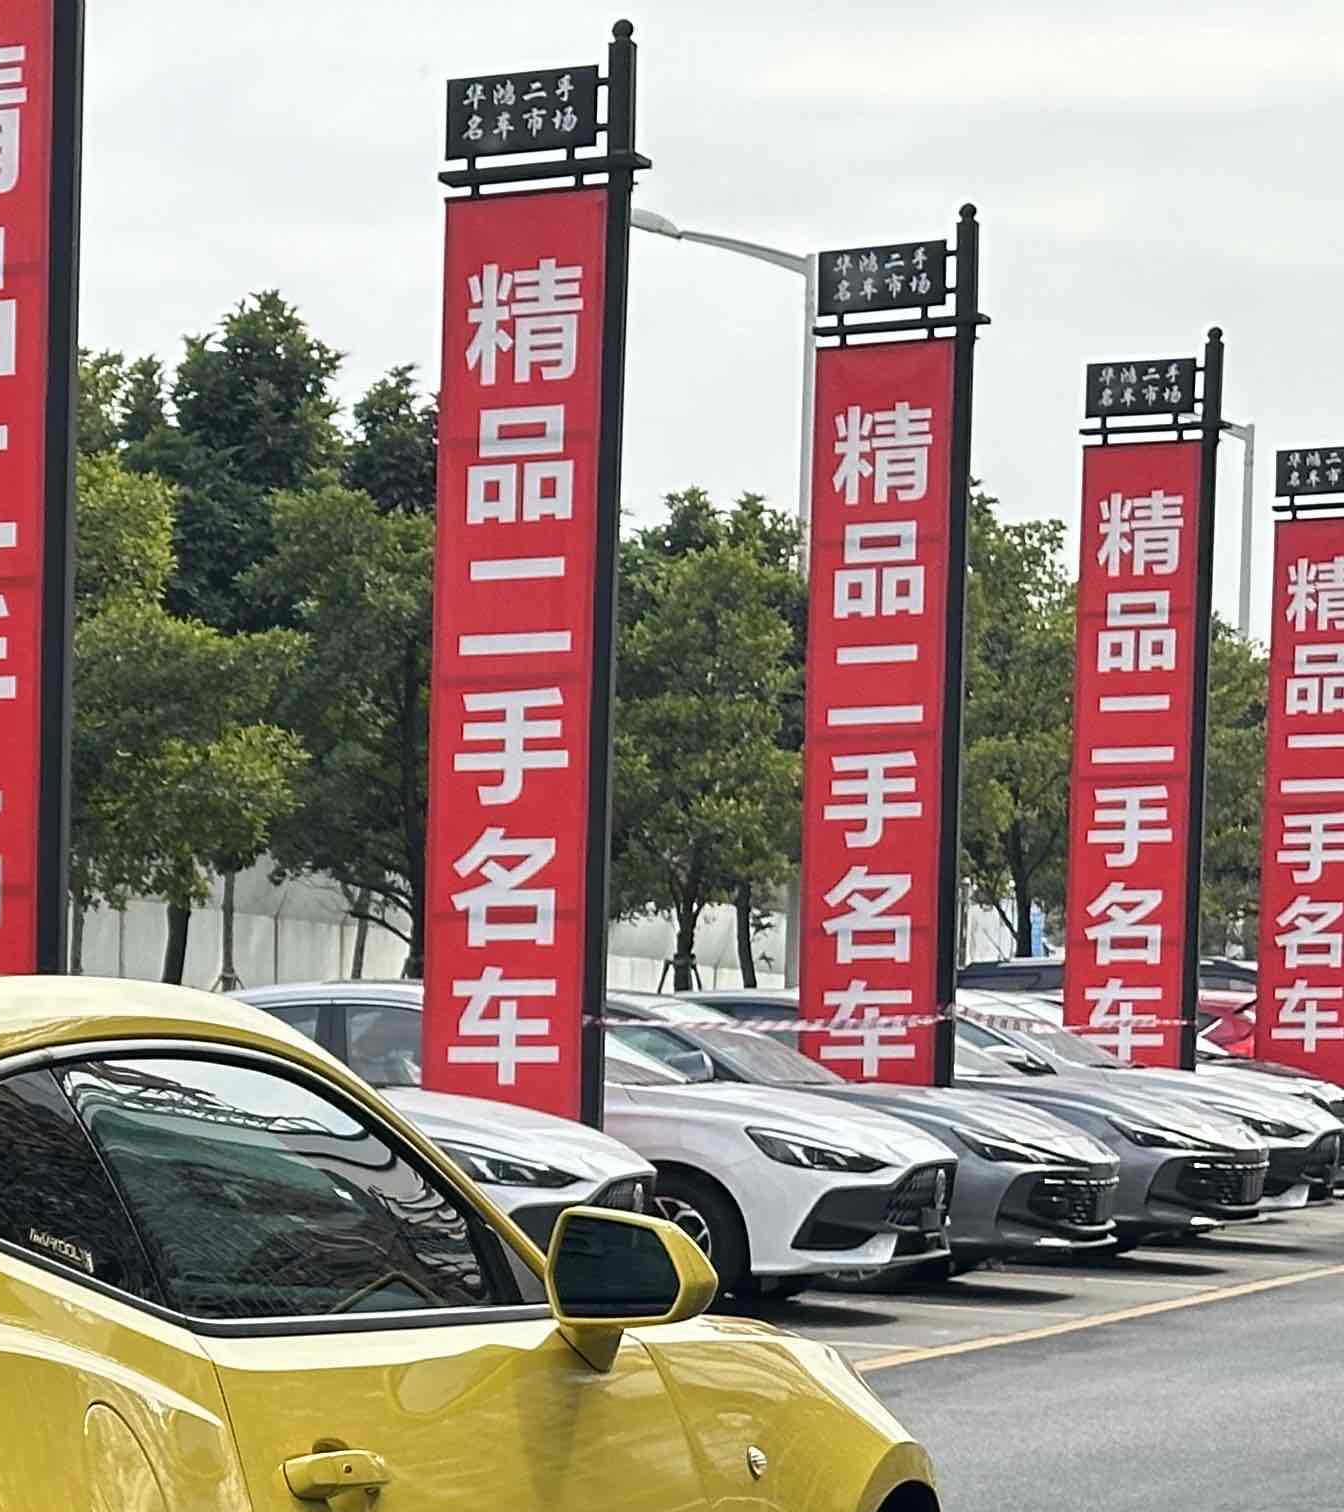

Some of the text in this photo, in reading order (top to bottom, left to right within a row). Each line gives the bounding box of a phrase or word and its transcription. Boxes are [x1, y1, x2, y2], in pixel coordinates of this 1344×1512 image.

[446, 257, 585, 1087] 精品二手名车
[821, 401, 934, 1078] 精品二手名车
[1083, 489, 1185, 1062] 精品二手名车
[1270, 556, 1344, 1053] 精品二手名车
